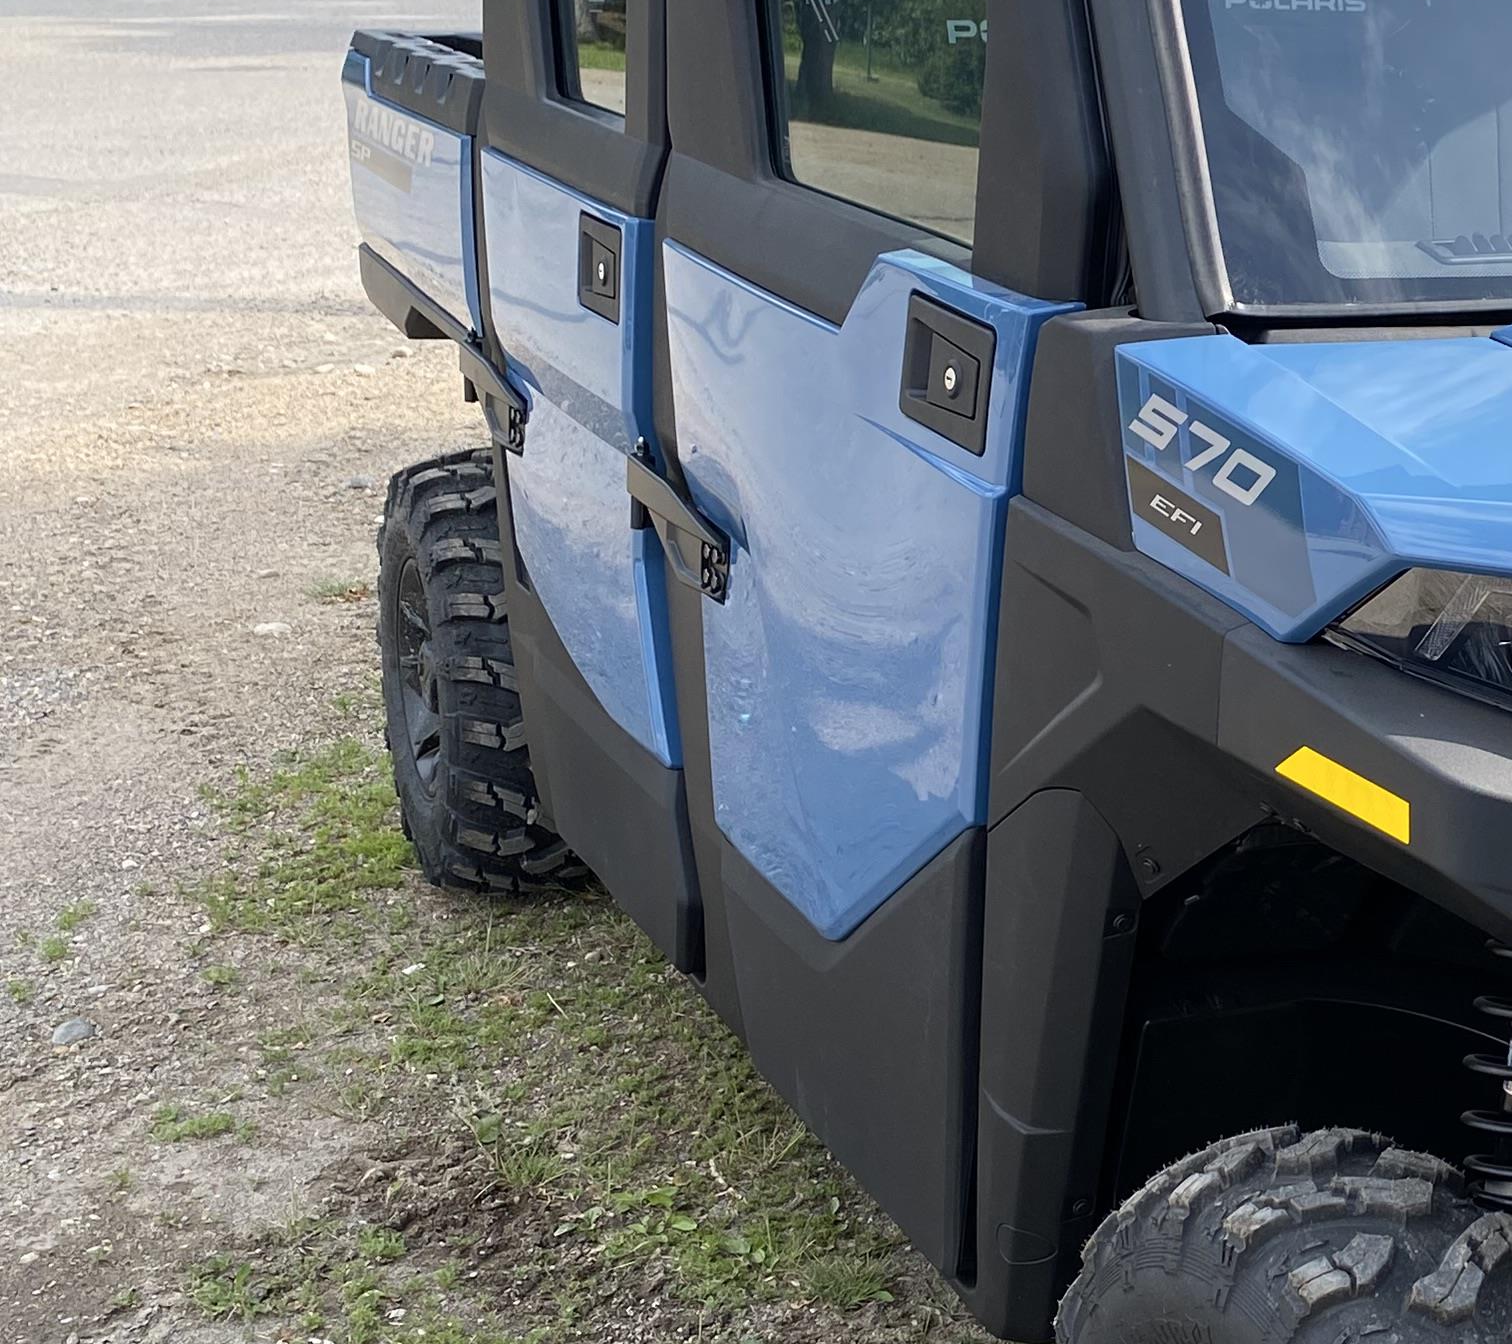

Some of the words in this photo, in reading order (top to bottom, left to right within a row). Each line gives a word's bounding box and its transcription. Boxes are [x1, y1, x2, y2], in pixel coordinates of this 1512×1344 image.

[351, 139, 371, 161] SP
[354, 98, 434, 168] RANGER
[1128, 393, 1277, 506] 570
[1149, 494, 1204, 536] EFI
